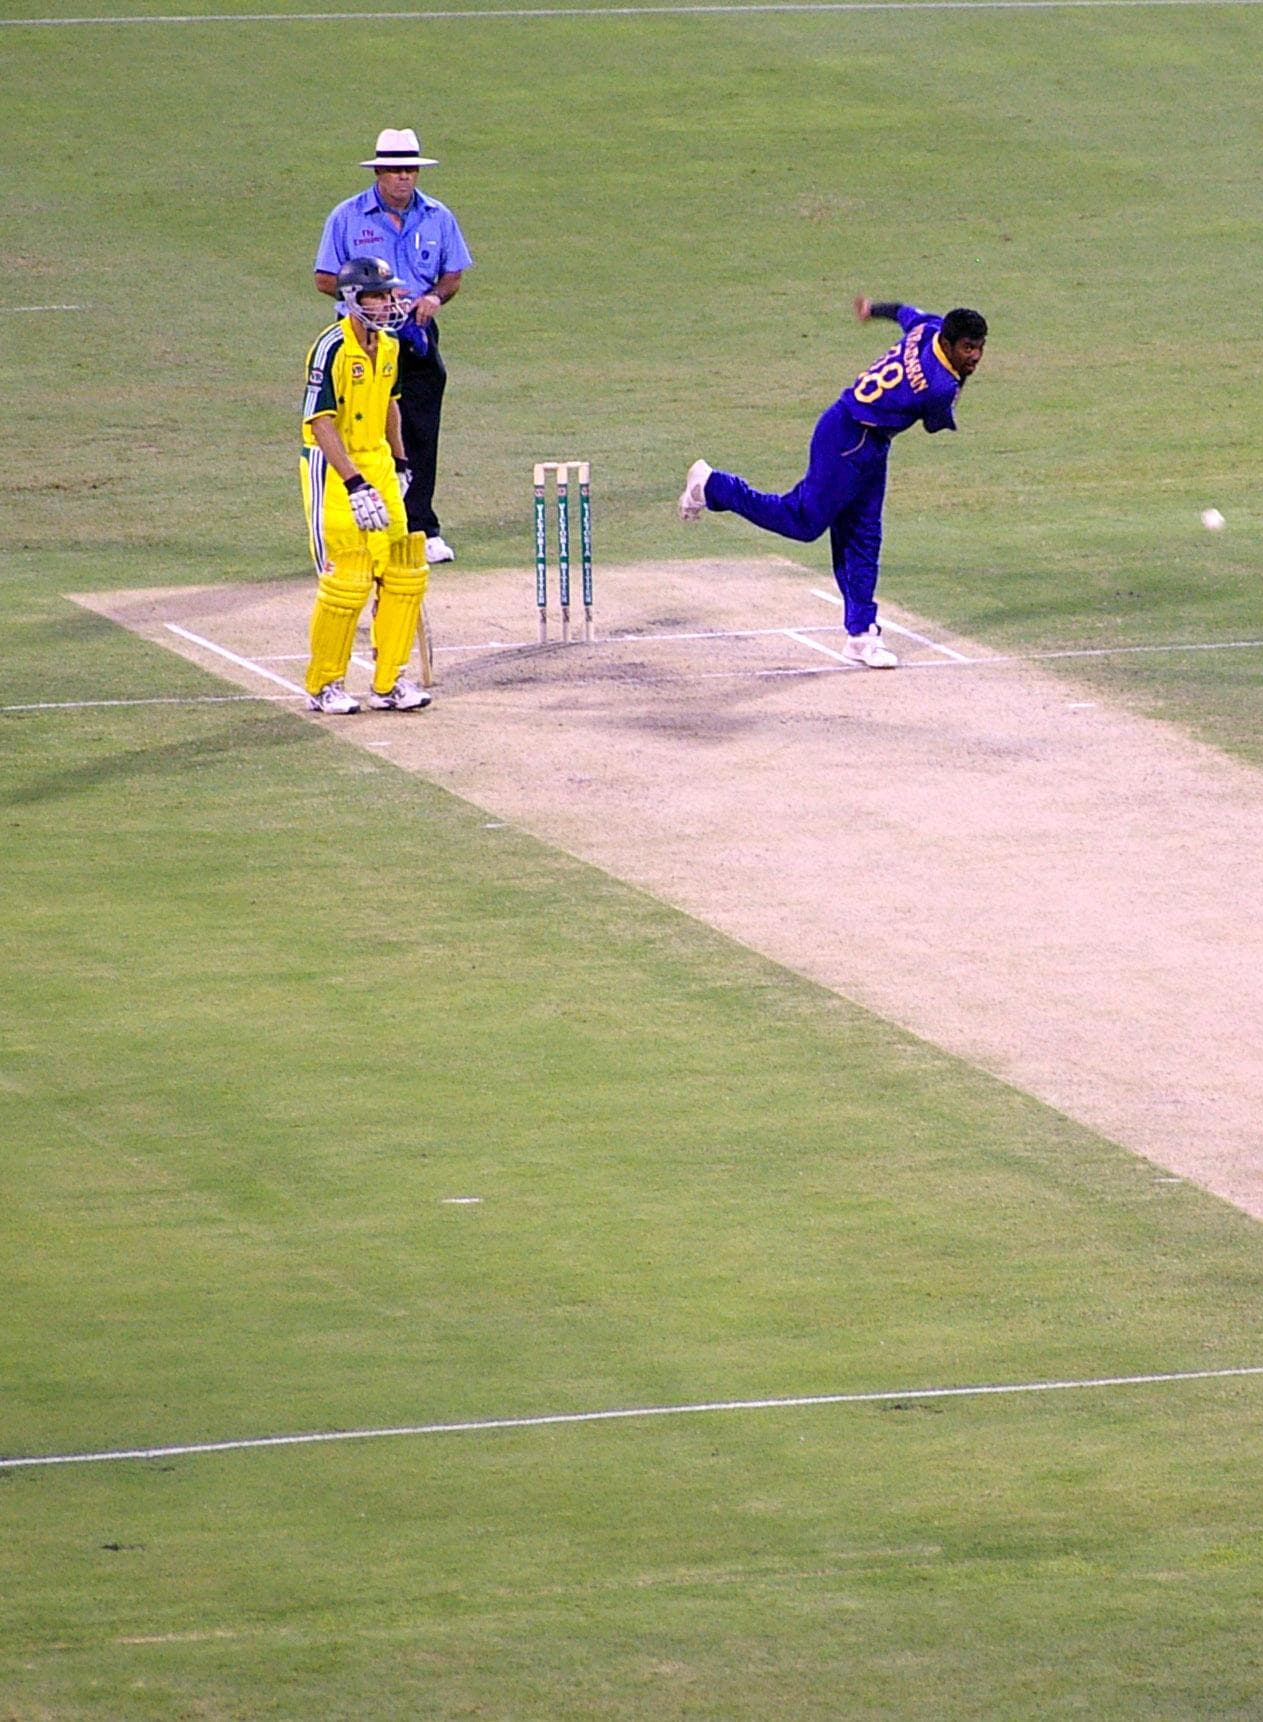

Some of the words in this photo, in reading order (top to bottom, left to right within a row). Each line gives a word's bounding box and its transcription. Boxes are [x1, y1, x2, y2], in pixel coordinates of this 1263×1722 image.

[353, 236, 385, 246] Emirates
[536, 504, 544, 558] VICTORIA
[558, 503, 567, 557] VICTORIA
[582, 502, 591, 557] VICTORIA
[537, 563, 545, 604] BITTER
